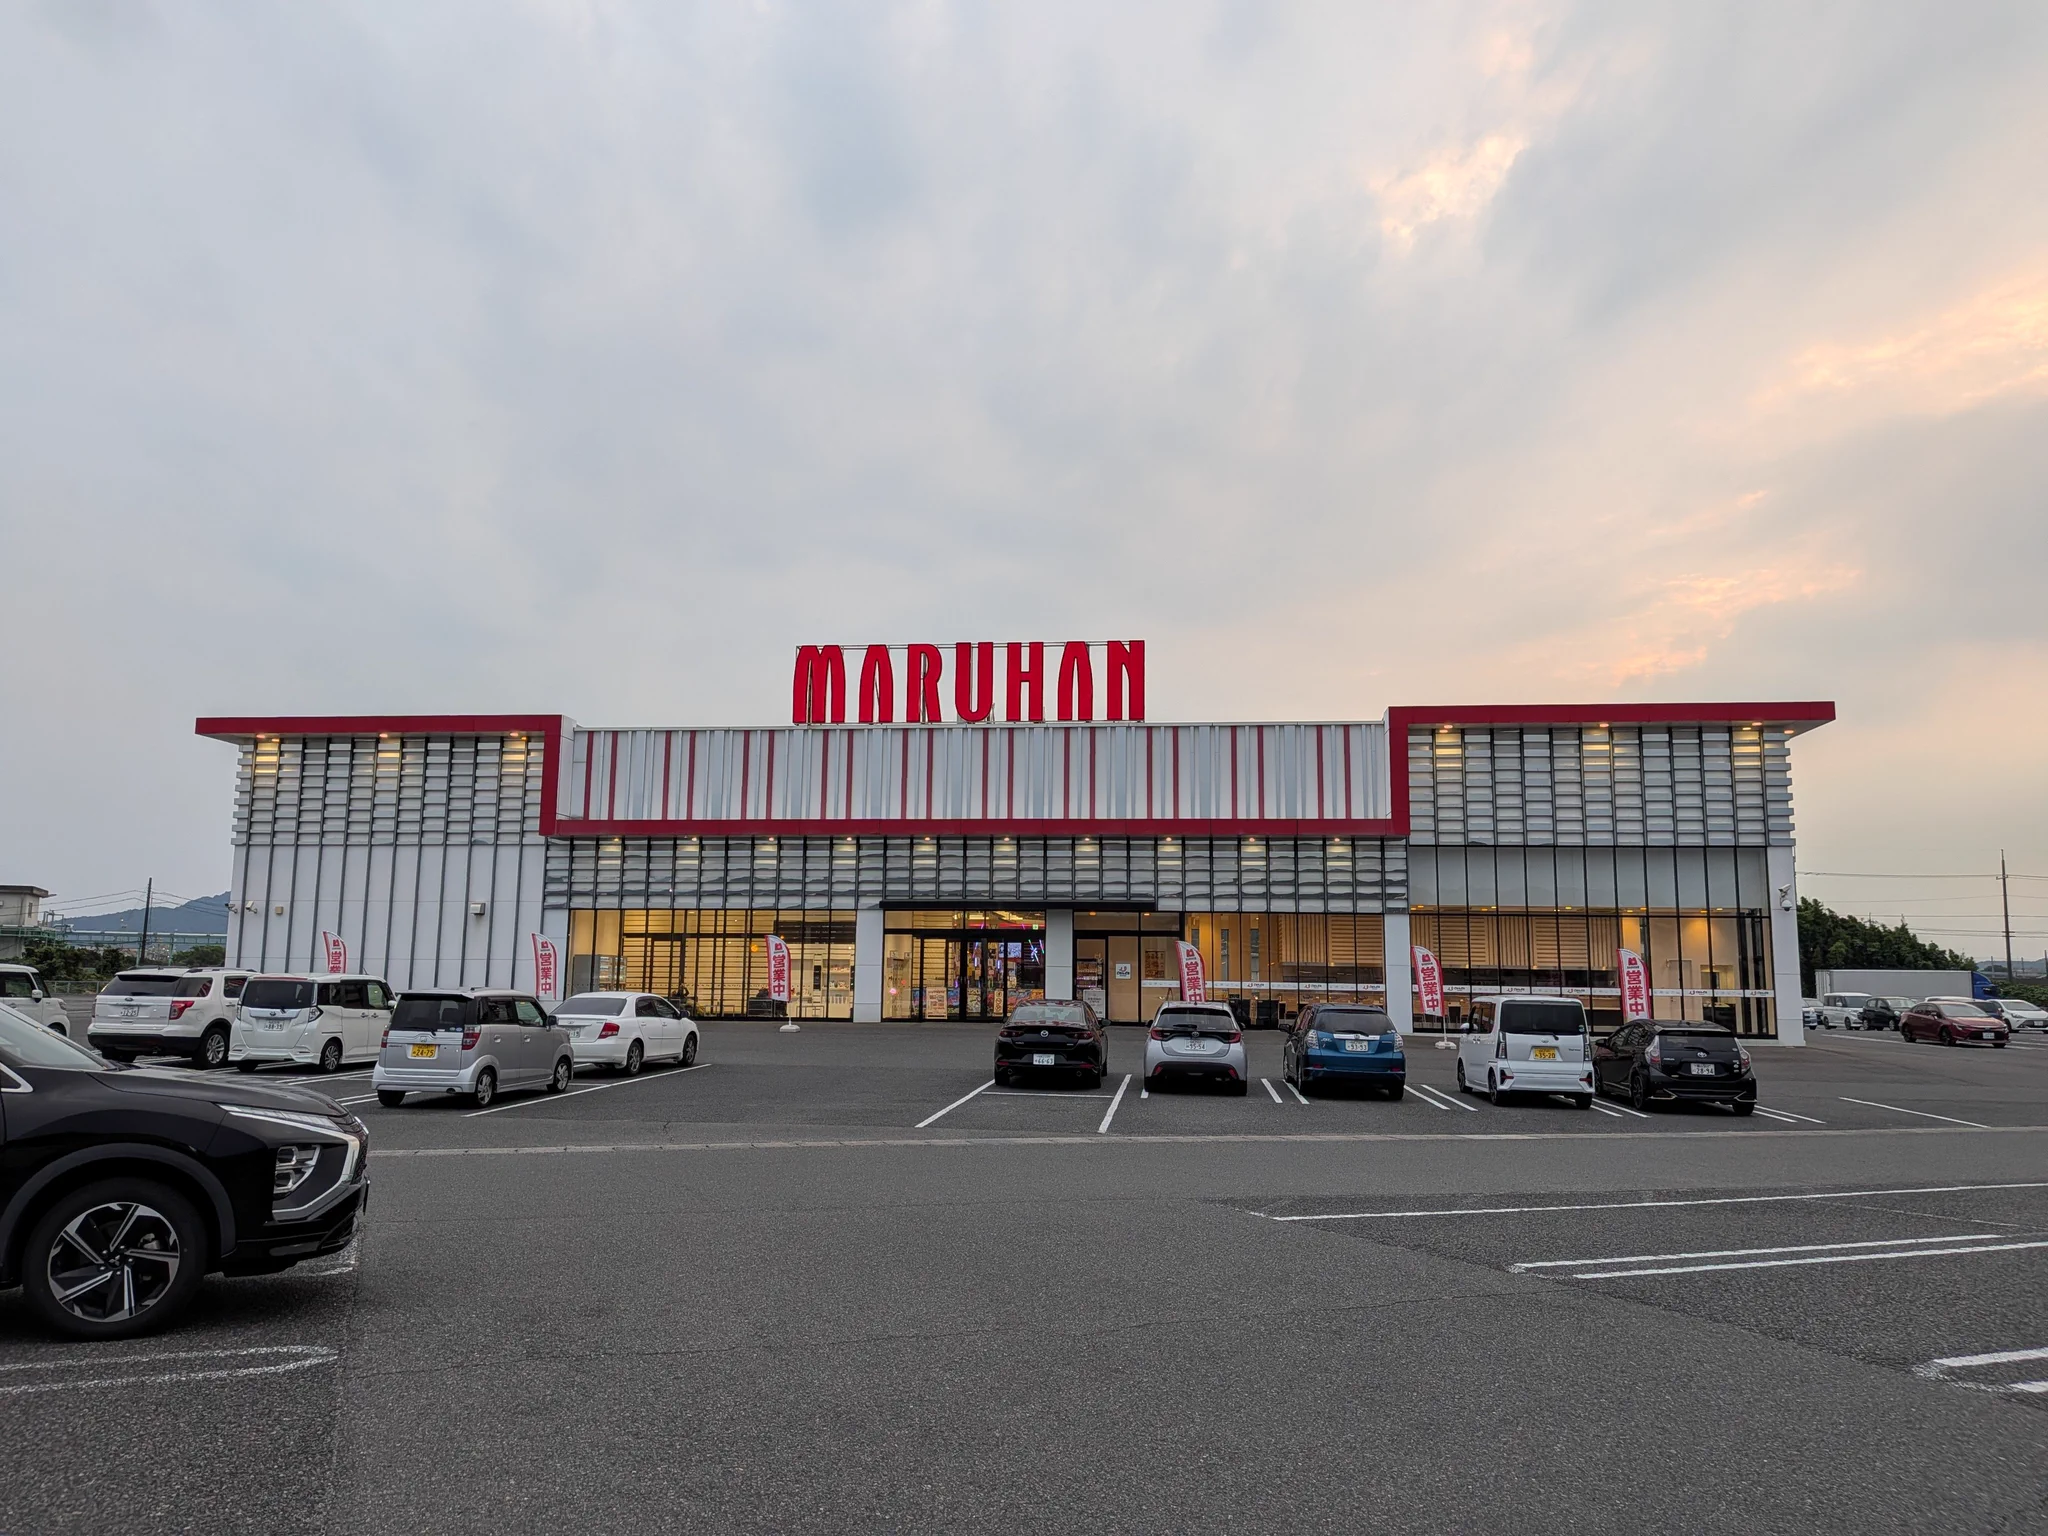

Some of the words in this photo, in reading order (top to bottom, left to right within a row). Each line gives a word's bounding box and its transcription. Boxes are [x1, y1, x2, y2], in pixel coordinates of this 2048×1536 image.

[793, 640, 1145, 724] MARUHAN
[540, 952, 552, 995] 営業中
[773, 954, 786, 997] 営業中
[1185, 961, 1202, 1003] 営業中
[1421, 966, 1439, 1012] 営業中
[1626, 970, 1645, 1016] 営業中
